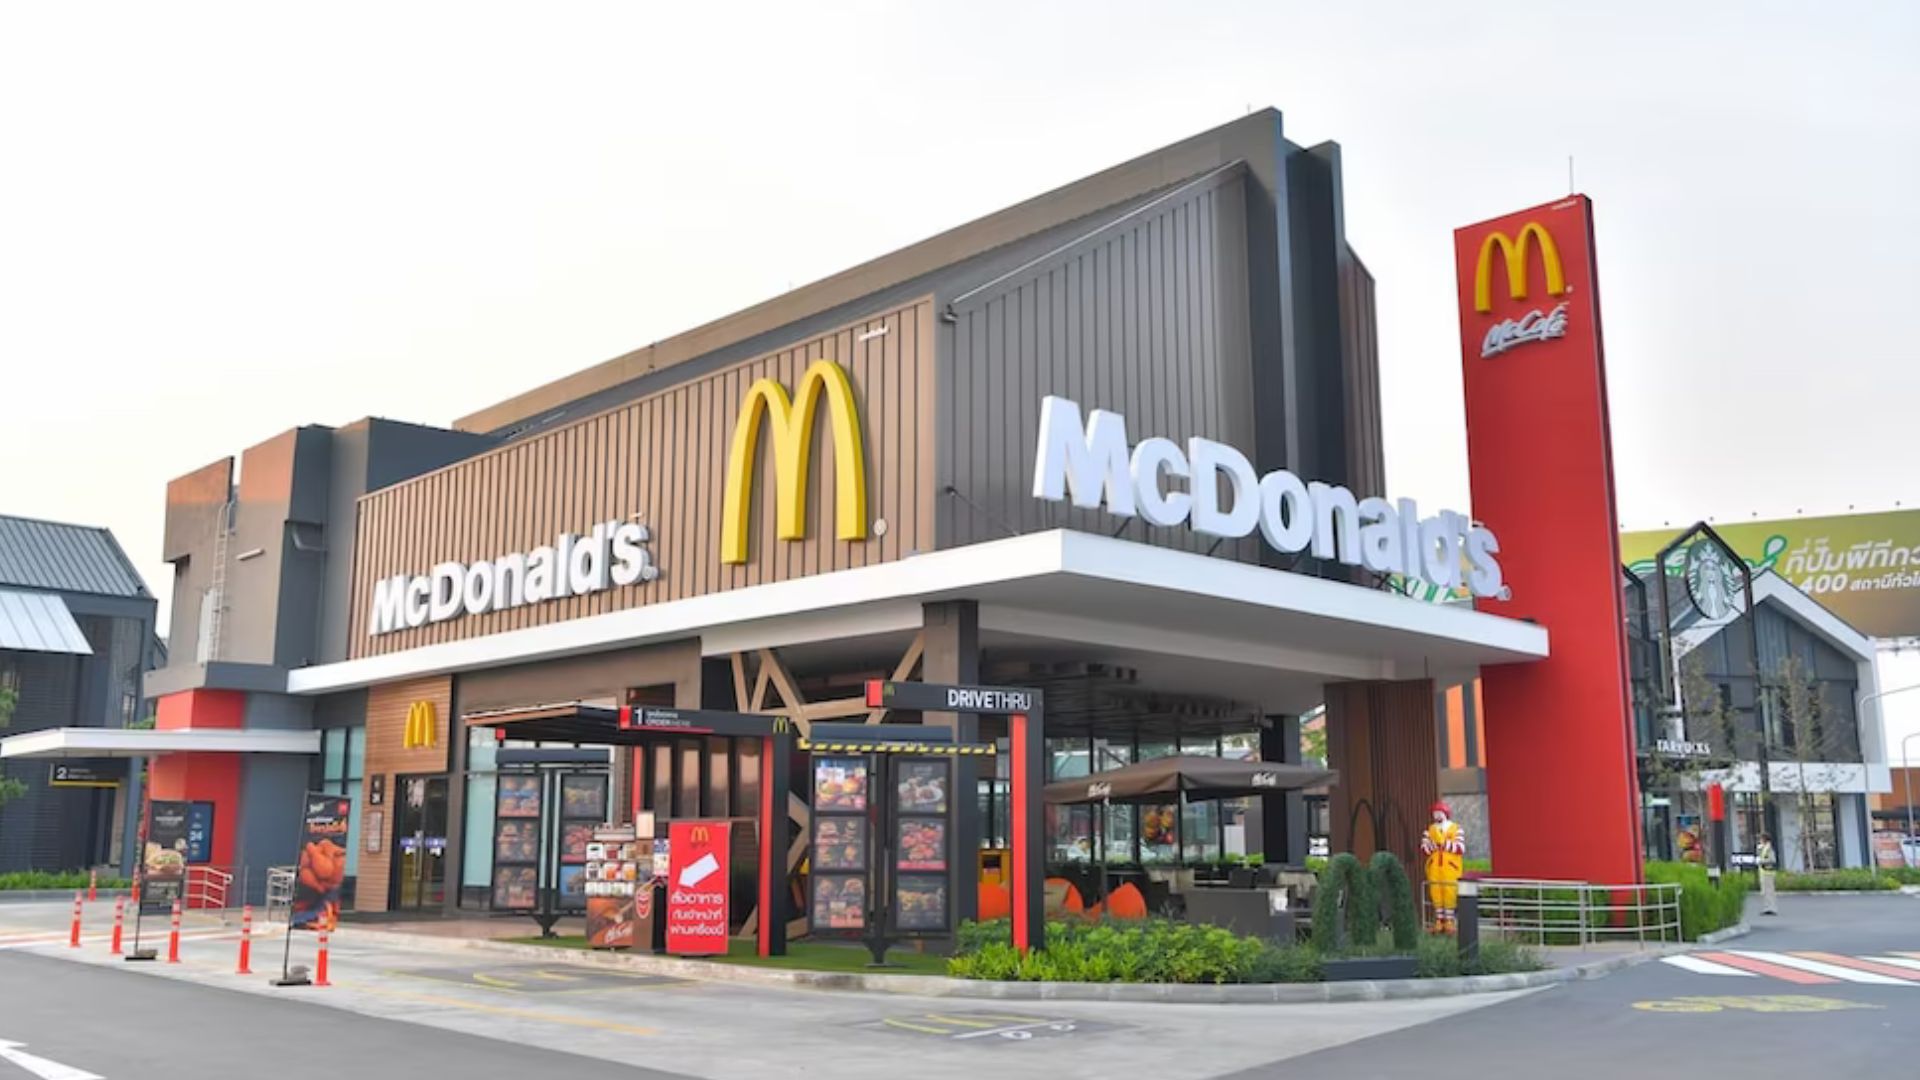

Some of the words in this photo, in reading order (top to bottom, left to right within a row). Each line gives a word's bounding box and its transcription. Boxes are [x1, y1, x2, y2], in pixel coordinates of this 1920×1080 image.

[1033, 395, 1504, 598] McDonald's
[369, 519, 652, 636] McDonald's
[634, 708, 644, 725] 1
[57, 766, 69, 780] 2
